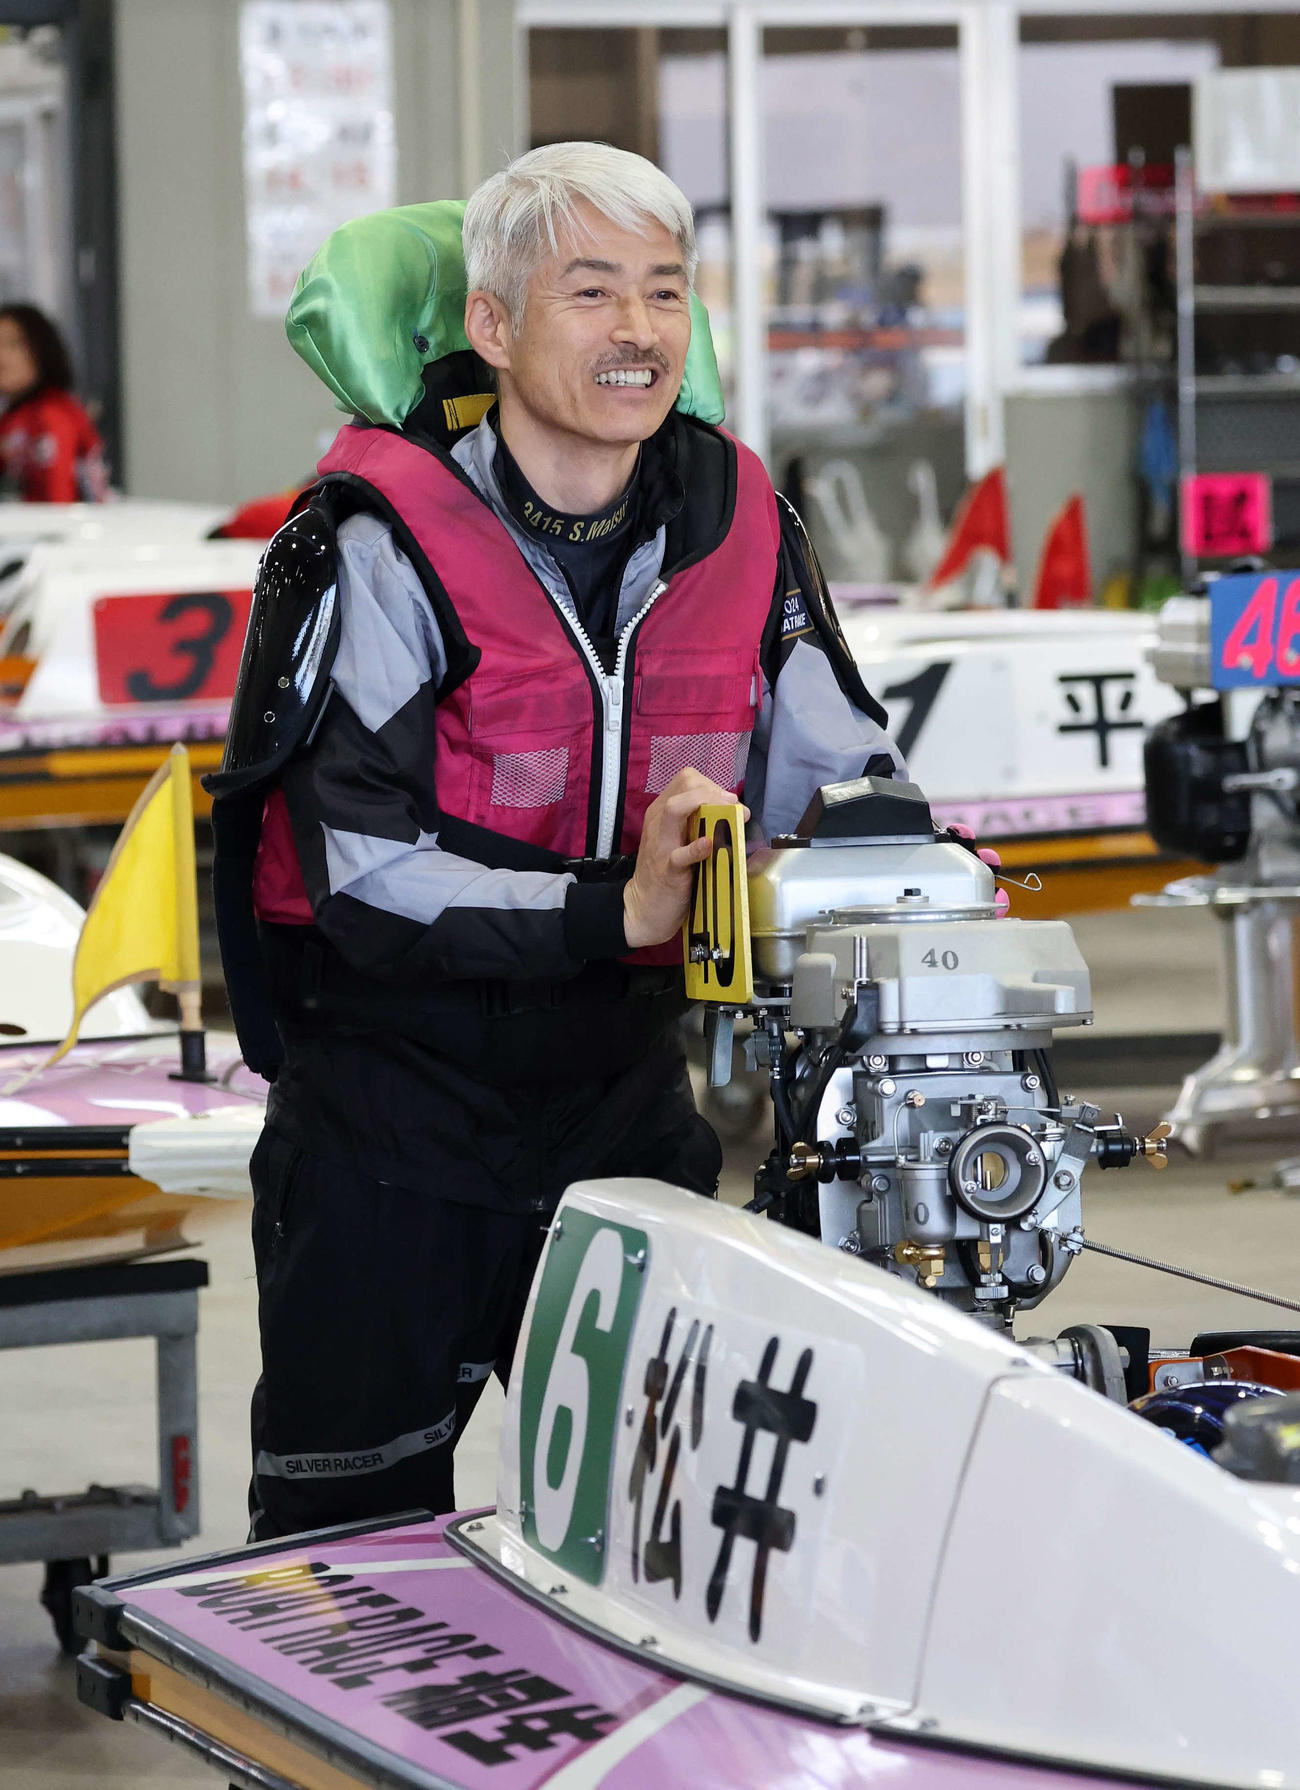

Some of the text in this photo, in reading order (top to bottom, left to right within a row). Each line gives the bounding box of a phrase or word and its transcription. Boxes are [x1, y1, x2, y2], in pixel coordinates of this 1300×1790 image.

[127, 592, 233, 702] 3
[882, 661, 953, 764] 1
[1058, 672, 1144, 768] 平
[689, 817, 736, 987] 40
[920, 947, 960, 971] 40
[534, 1227, 624, 1553] 6
[285, 1453, 384, 1474] SILVER RACER
[628, 1307, 818, 1644] 松井
